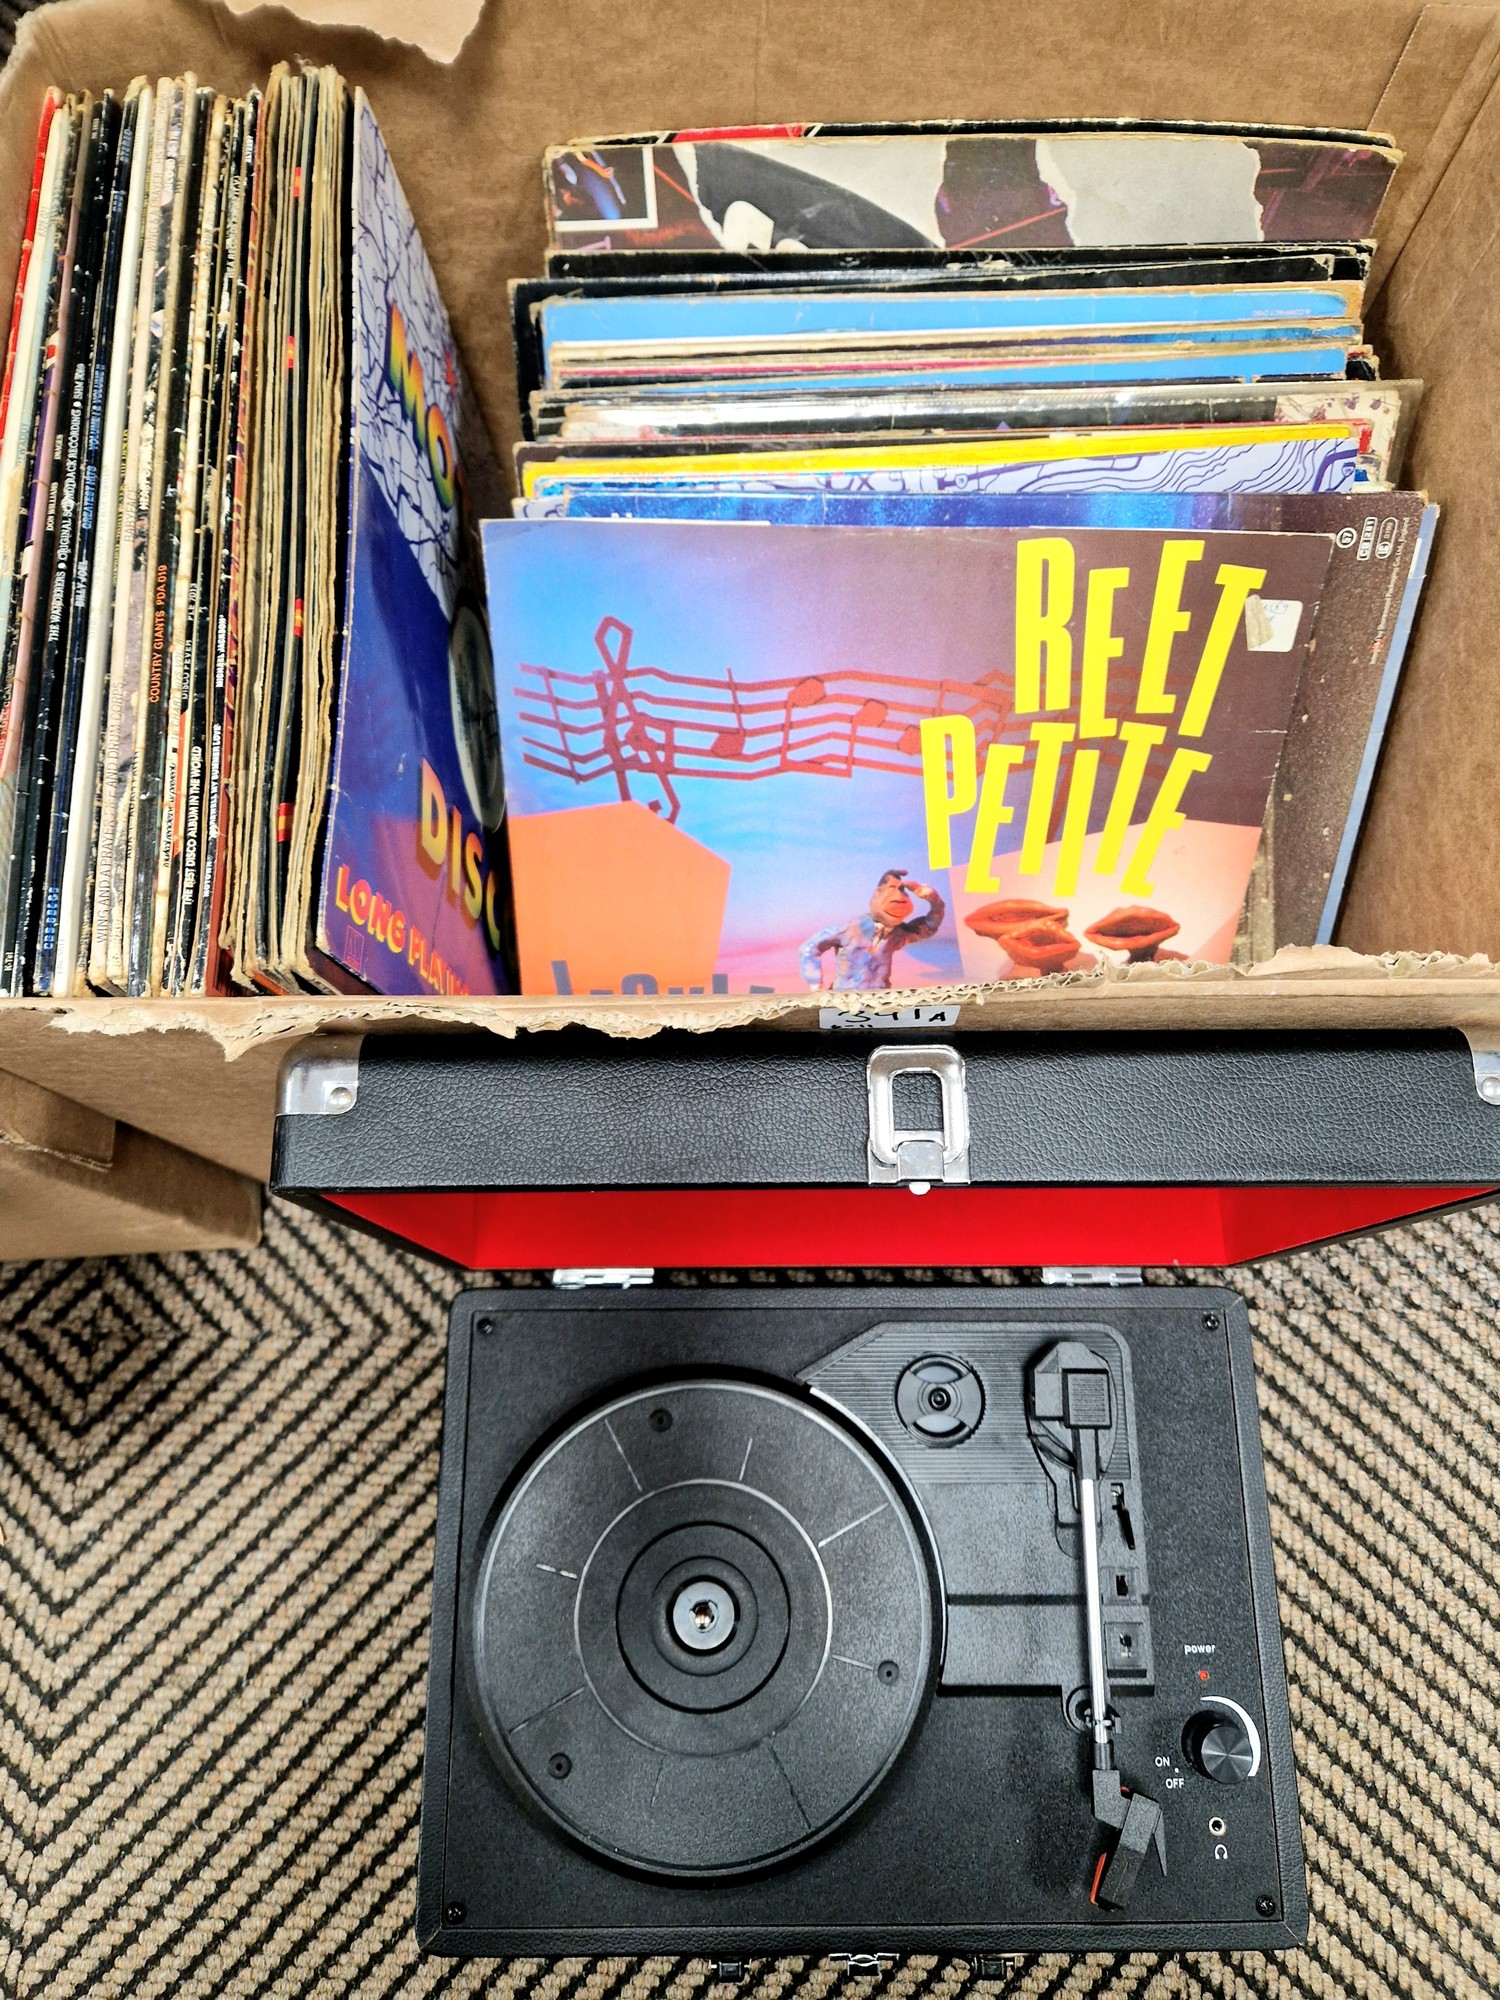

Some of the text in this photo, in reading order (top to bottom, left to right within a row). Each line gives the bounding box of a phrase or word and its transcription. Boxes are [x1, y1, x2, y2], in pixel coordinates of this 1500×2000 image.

[73, 381, 84, 400] SHM
[92, 372, 104, 404] VOLUME
[54, 434, 64, 460] IMAGES
[67, 409, 81, 458] RECORDING
[88, 417, 101, 450] VOLUME
[84, 465, 97, 485] HITS
[46, 516, 55, 531] DON
[81, 486, 95, 530] GREATEST
[124, 485, 137, 542] BABYFACE
[57, 518, 72, 560] ORIGINAL
[77, 560, 89, 582] JOEL
[50, 571, 66, 623] WANDERERS
[75, 582, 87, 607] BILLY
[48, 624, 59, 642] THE
[149, 565, 167, 703] COUNTRY GIANTS PDA 019
[1015, 537, 1267, 739] REET
[215, 653, 225, 688] MICHAEL
[111, 683, 124, 720] CORPS
[107, 724, 120, 759] DRUM
[106, 762, 118, 788] AND
[211, 746, 220, 780] SUMMER
[210, 781, 219, 793] MY
[920, 715, 1212, 898] PETITE
[183, 746, 202, 905] THE BEST DISCO ALBUM IN THE WORLD
[100, 820, 115, 866] PRAYER
[98, 880, 110, 906] AND
[336, 863, 406, 953] LONG
[97, 910, 108, 943] WING
[1184, 1643, 1216, 1655] power
[1155, 1756, 1170, 1767] ON
[1165, 1777, 1184, 1789] OFF
